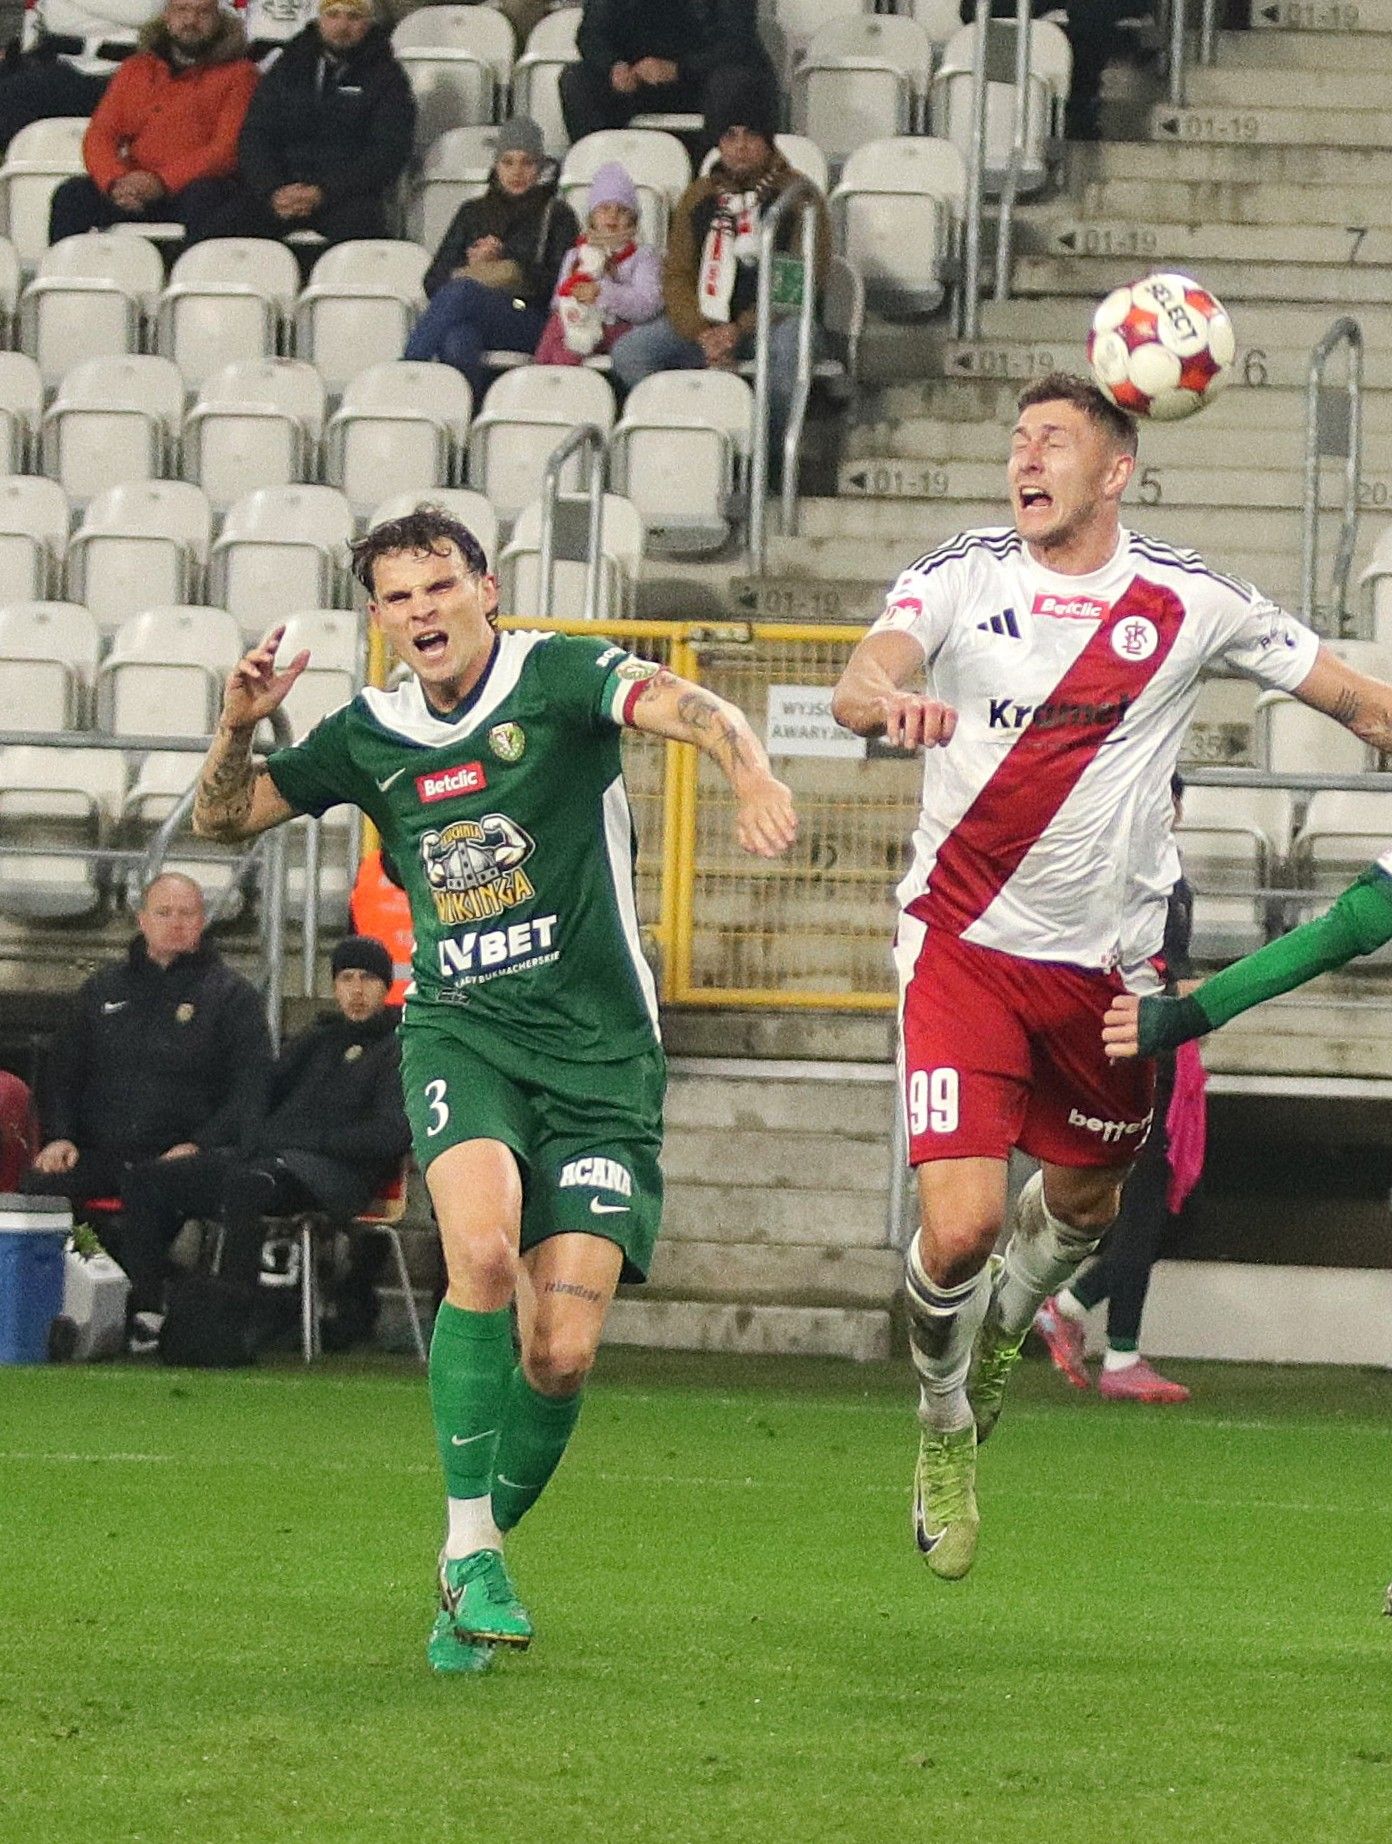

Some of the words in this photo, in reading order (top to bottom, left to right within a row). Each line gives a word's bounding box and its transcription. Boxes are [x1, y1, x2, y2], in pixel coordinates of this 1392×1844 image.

[1185, 116, 1259, 140] 01-19
[1082, 229, 1157, 252] 01-19
[1346, 226, 1367, 262] 7
[1151, 283, 1198, 340] SELECT
[979, 351, 1054, 375] 01-19
[1244, 350, 1267, 386] 6
[873, 467, 949, 494] 01-19
[1138, 467, 1162, 505] 5
[1041, 599, 1102, 617] Betclic
[424, 768, 479, 797] Betclic
[425, 1078, 449, 1138] 3
[910, 1067, 960, 1136] 99
[559, 1156, 632, 1198] ACANA
